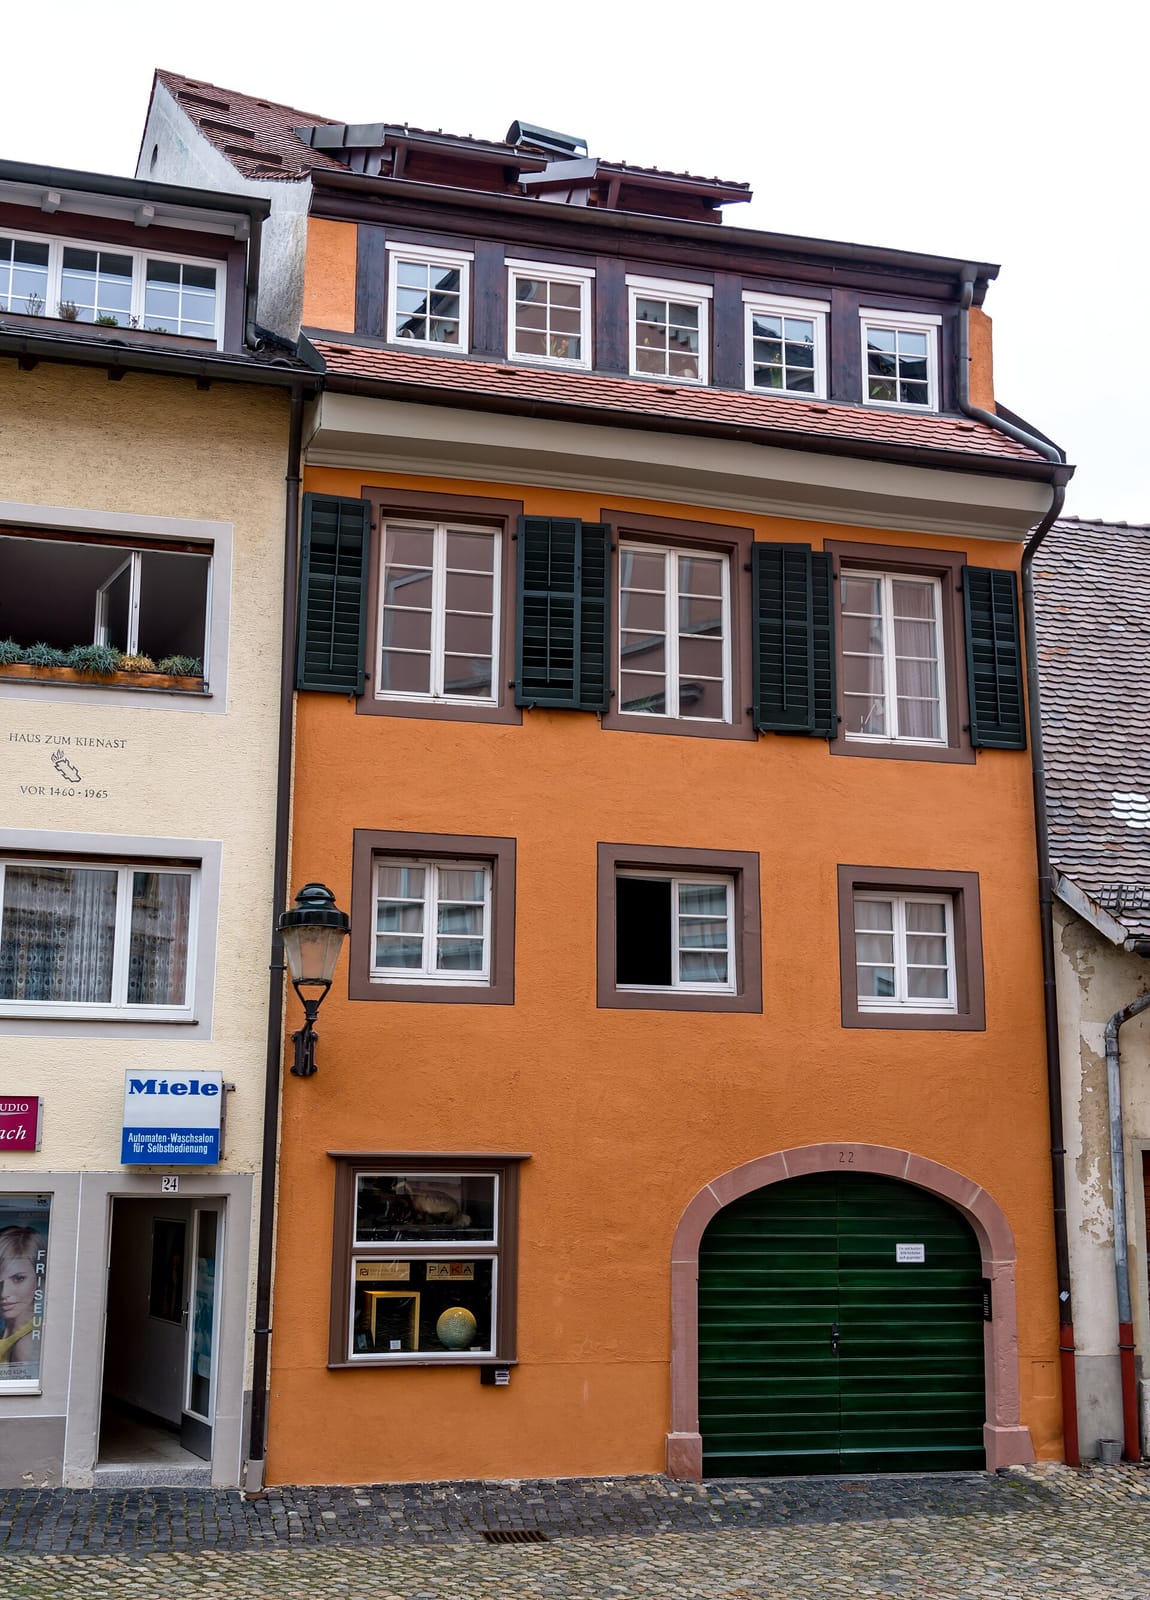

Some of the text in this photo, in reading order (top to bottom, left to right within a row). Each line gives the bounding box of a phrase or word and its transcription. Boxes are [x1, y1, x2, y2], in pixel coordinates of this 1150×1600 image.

[9, 732, 127, 749] HAUS ZUM KIENAST
[20, 785, 46, 796] VOR
[128, 1079, 219, 1096] Miele
[133, 1143, 208, 1154] für Selbstbedienung
[839, 1152, 854, 1163] 22
[163, 1178, 177, 1191] 24
[32, 1250, 46, 1341] FRISEUR
